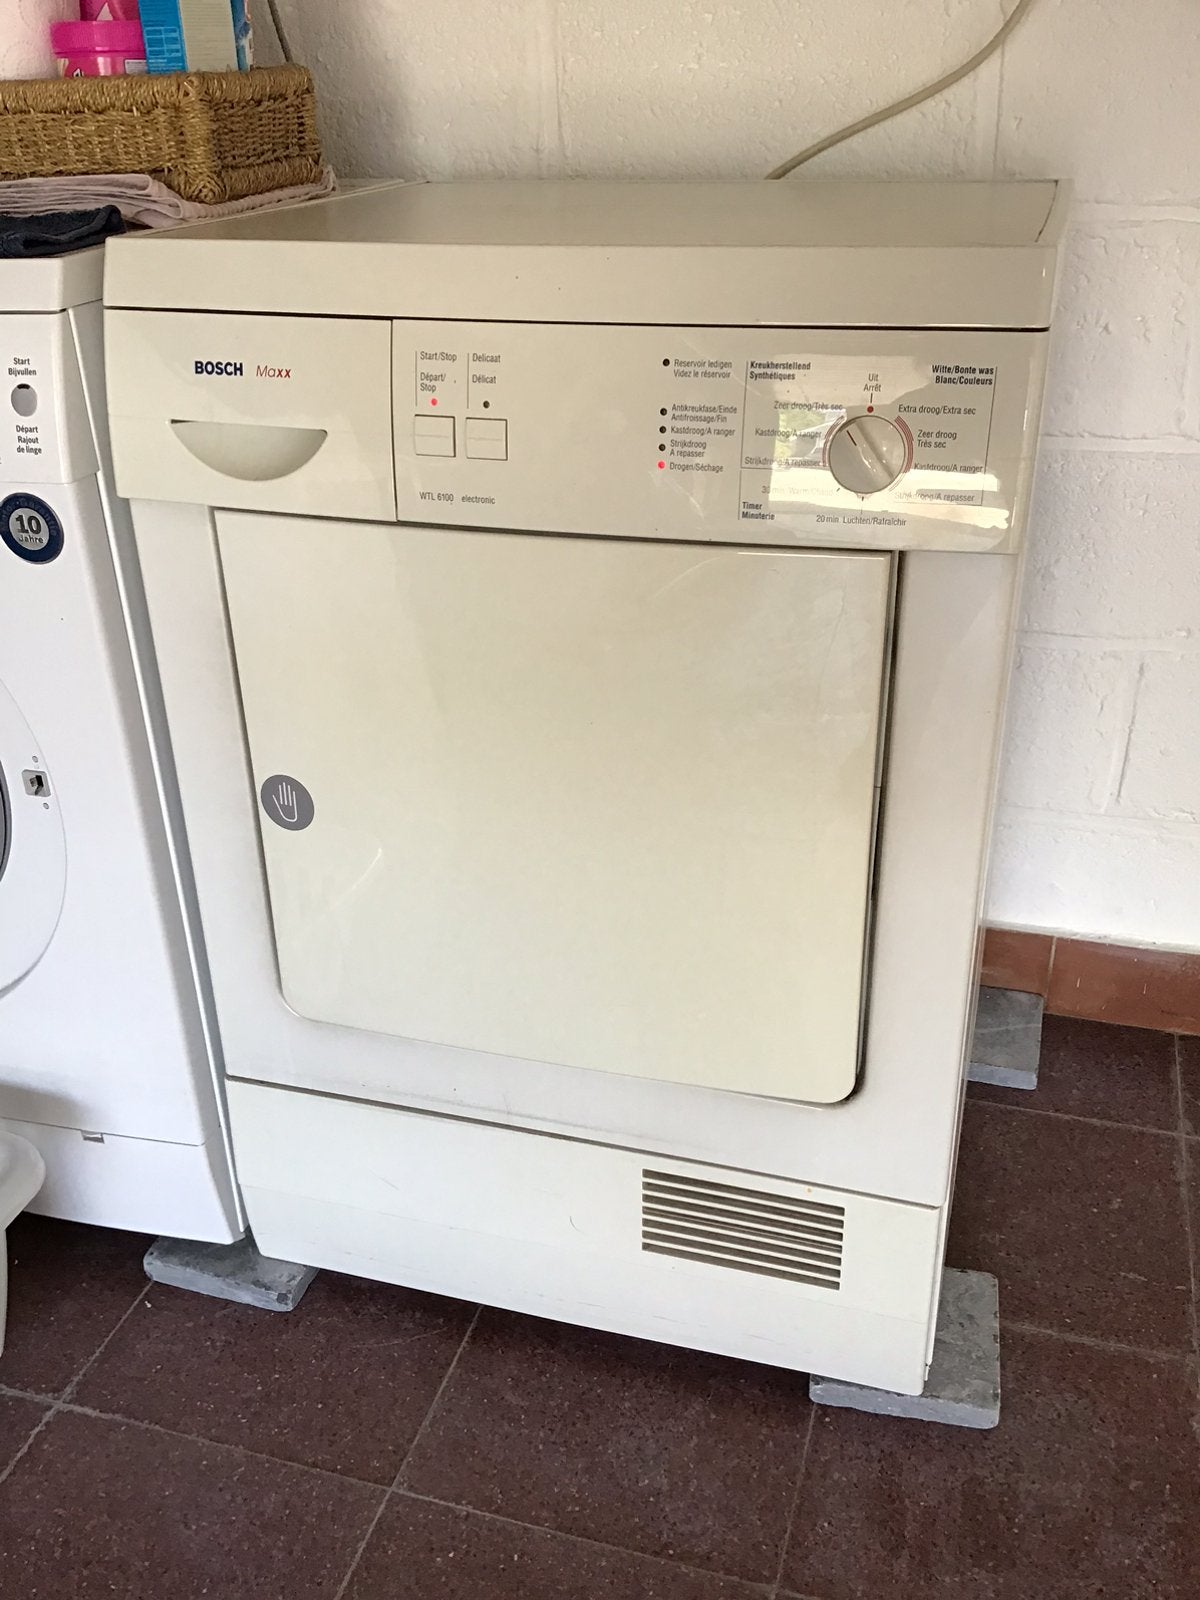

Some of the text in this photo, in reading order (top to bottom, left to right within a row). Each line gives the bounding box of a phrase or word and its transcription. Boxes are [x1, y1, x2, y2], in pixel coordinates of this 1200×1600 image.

[13, 357, 30, 365] Start
[420, 351, 457, 362] Start/Stop
[472, 353, 501, 363] Delicaat
[194, 361, 292, 378] BOSCH Maxx
[674, 359, 732, 370] Reservoir ledigen
[750, 361, 811, 370] Kreukherstellend
[8, 368, 37, 377] Bijvullen
[674, 369, 691, 378] Videz
[700, 370, 731, 379] réservoir
[932, 365, 994, 375] Witte/Bonte was
[420, 372, 446, 382] Départ/
[472, 374, 497, 384] Délicat
[750, 371, 795, 381] Synthétiques
[868, 373, 878, 381] Uit
[935, 376, 993, 385] Blanc/Couleurs
[420, 382, 436, 393] Stop
[864, 384, 881, 392] Arrêt
[672, 404, 737, 414] Antikreukfase/Einde
[898, 404, 976, 415] Extra droog/Extra sec
[671, 414, 727, 423] Antifroissage/Fin
[16, 425, 38, 434] Départ
[671, 426, 735, 437] Kastdroog/A ranger
[918, 429, 957, 440] Zeer droog
[17, 436, 39, 445] Rajout
[670, 439, 707, 449] Strijkdroog
[918, 440, 946, 449] Très sec
[26, 446, 42, 455] linge
[677, 450, 705, 458] repasser
[670, 462, 723, 473] Drogen/Séchage
[419, 491, 496, 504] WTL 6100 electronic
[943, 493, 975, 502] repasser
[742, 502, 762, 510] Timer
[742, 511, 775, 520] Minuterie
[816, 514, 826, 523] 20
[15, 514, 42, 535] 10
[19, 534, 44, 544] Jahre
